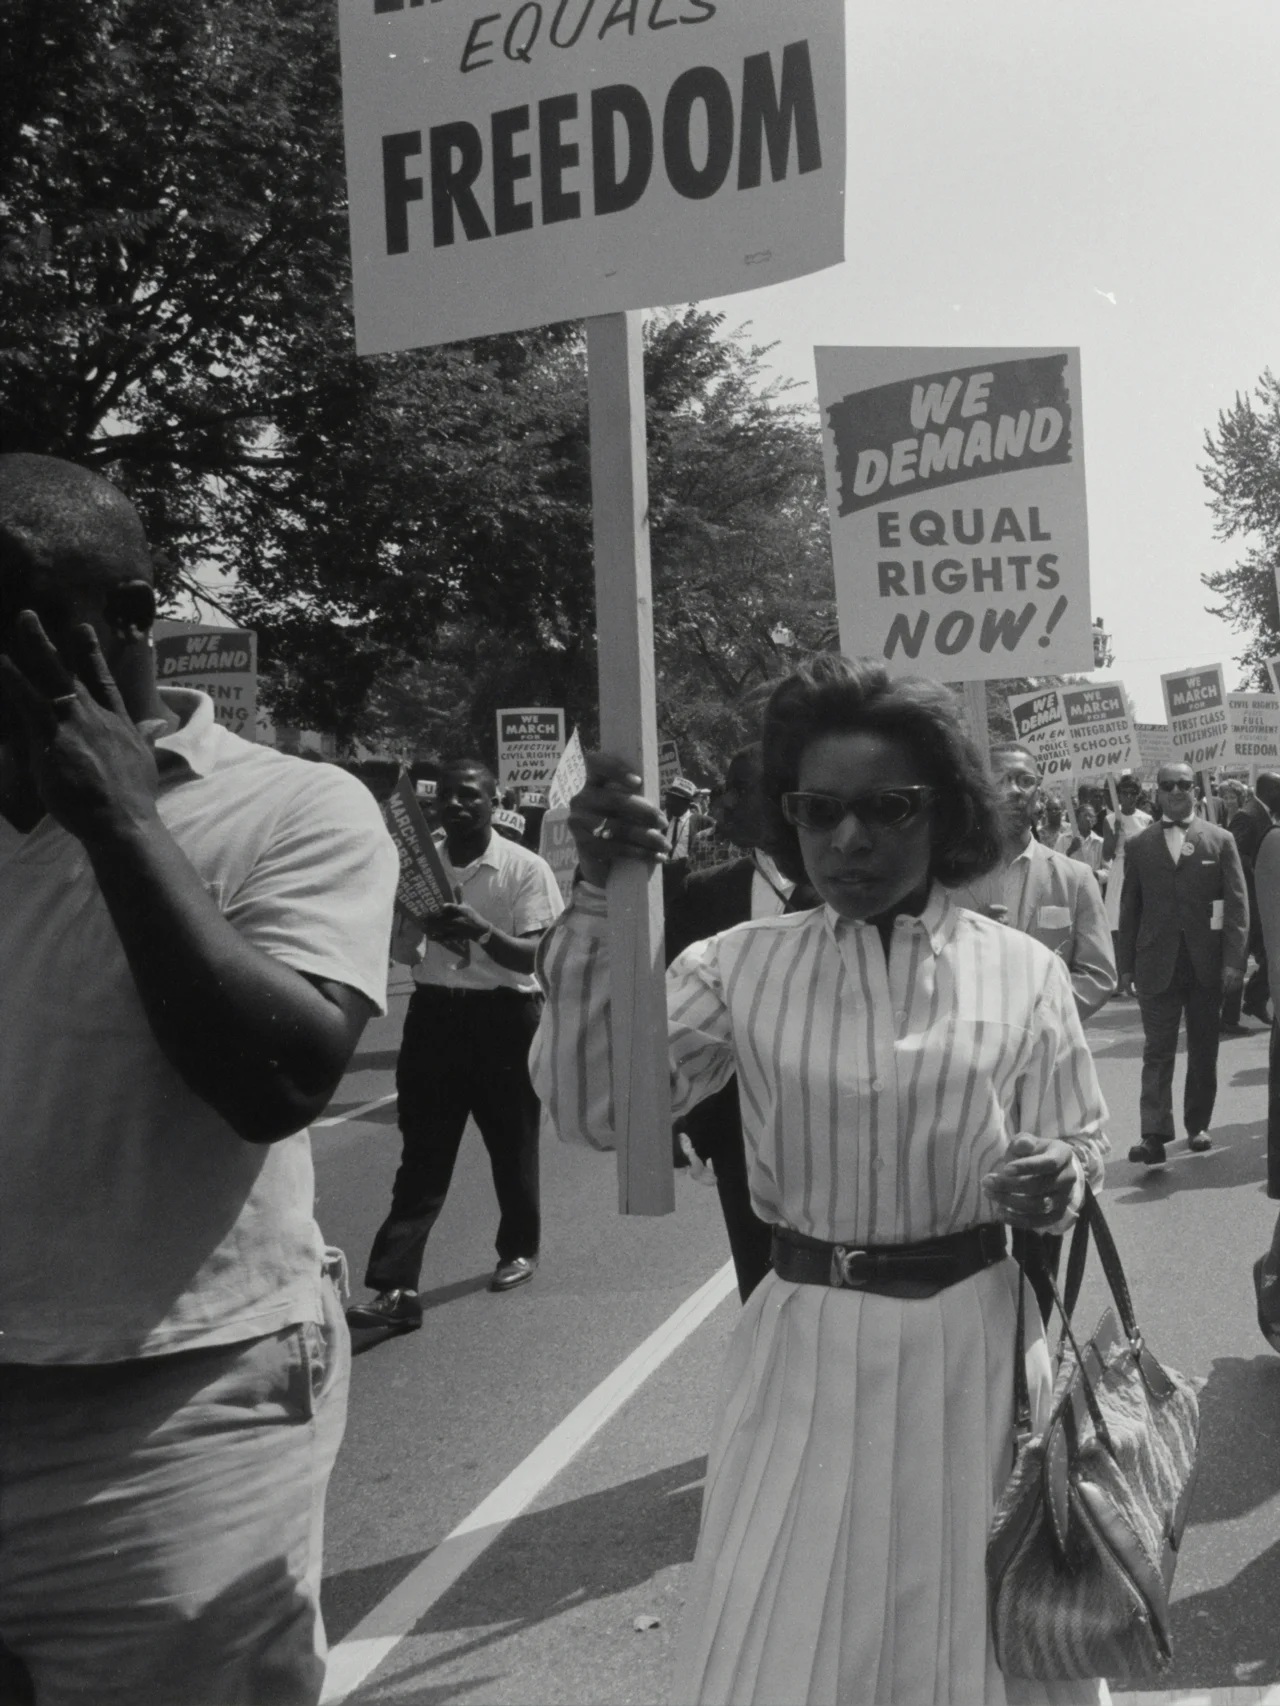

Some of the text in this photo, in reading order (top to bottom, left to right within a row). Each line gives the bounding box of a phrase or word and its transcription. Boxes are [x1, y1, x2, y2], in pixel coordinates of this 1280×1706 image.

[381, 39, 823, 256] FREEDOM
[910, 371, 994, 430] WE
[853, 407, 1064, 497] DEMAND
[877, 506, 1051, 548] EQUAL
[877, 553, 1060, 597] RIGHTS
[883, 594, 1068, 660] NOW!
[186, 635, 222, 653] WE
[163, 650, 249, 675] DEMAND
[1185, 676, 1201, 688] WE
[1033, 694, 1056, 713] WE
[1083, 690, 1102, 702] WE
[1172, 684, 1217, 706] MARCH
[1070, 698, 1120, 717] MARCH
[1188, 701, 1206, 711] FOR
[1229, 700, 1280, 710] CIVIL RIGHTS
[521, 715, 539, 723] WE
[1021, 707, 1060, 734] DEMA
[1087, 712, 1107, 720] FOR
[1172, 710, 1226, 732] FIRST CLASS
[1243, 716, 1264, 725] FULL
[506, 724, 556, 735] MARCH
[1028, 728, 1065, 743] AN EN
[1069, 720, 1129, 739] INTEGRATED
[1172, 723, 1228, 746] CITIZENSHIP
[507, 743, 557, 751] EFFECTIVE
[1039, 740, 1068, 753] POLICE
[1073, 734, 1131, 753] SCHOOLS
[1183, 739, 1227, 764] NOW!
[1235, 743, 1278, 756] REEDOM
[501, 752, 524, 760] CIVIL
[516, 760, 545, 768] LAWS
[1081, 746, 1131, 770] NOW!
[1036, 758, 1072, 775] NOW
[390, 792, 419, 847] MARCH
[410, 874, 440, 913] FREEDO
